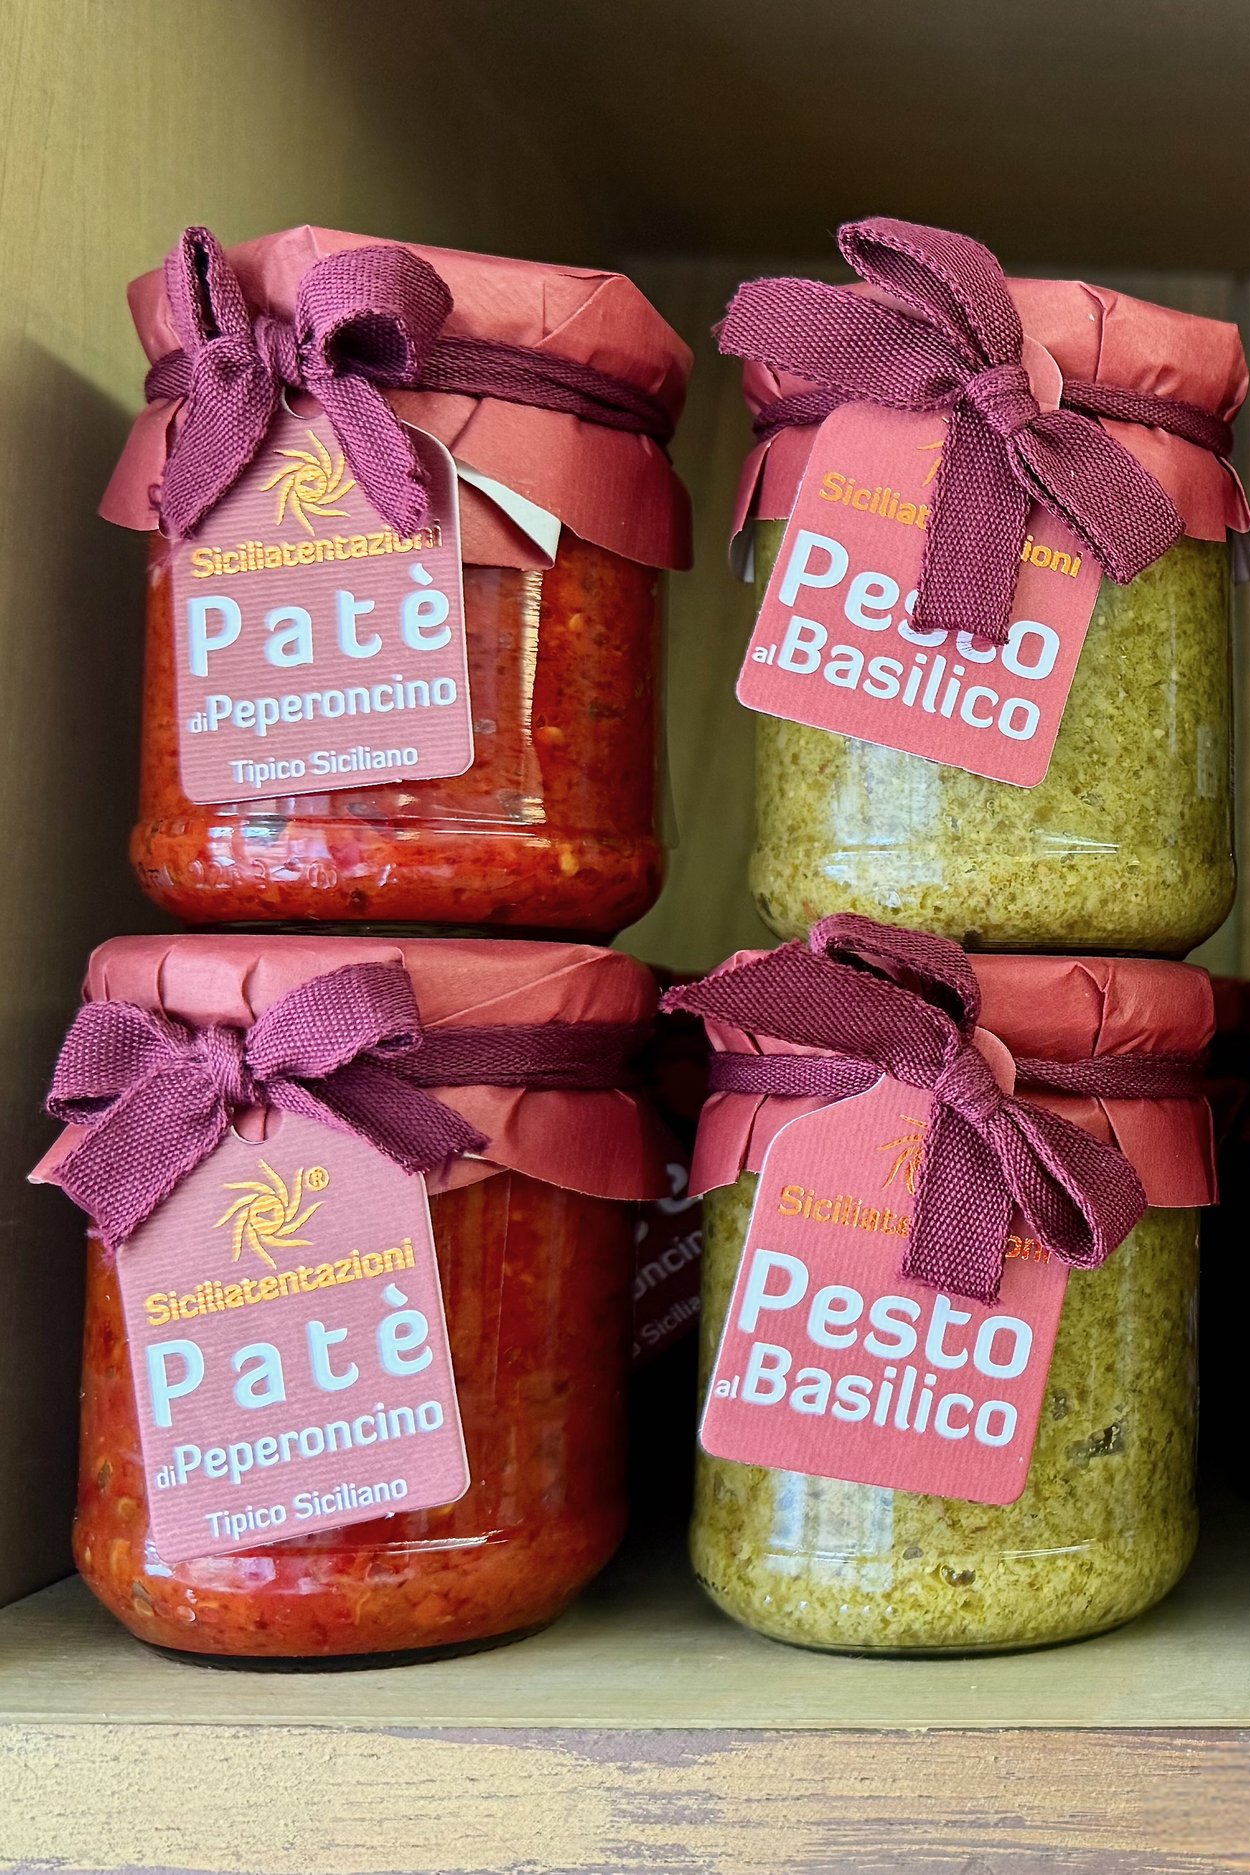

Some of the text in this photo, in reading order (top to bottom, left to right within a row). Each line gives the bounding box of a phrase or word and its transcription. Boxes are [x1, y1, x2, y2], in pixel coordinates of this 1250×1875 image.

[818, 471, 1082, 579] Siciliationi
[186, 563, 452, 678] Patè
[230, 746, 418, 788] Tipico Siciliano
[144, 1237, 415, 1326] Siciliatentazioni
[640, 1294, 700, 1347] Sicilia
[737, 1248, 1033, 1379] Pesto
[144, 1283, 434, 1428] Patè
[205, 1477, 408, 1541] Tipico Siciliano
